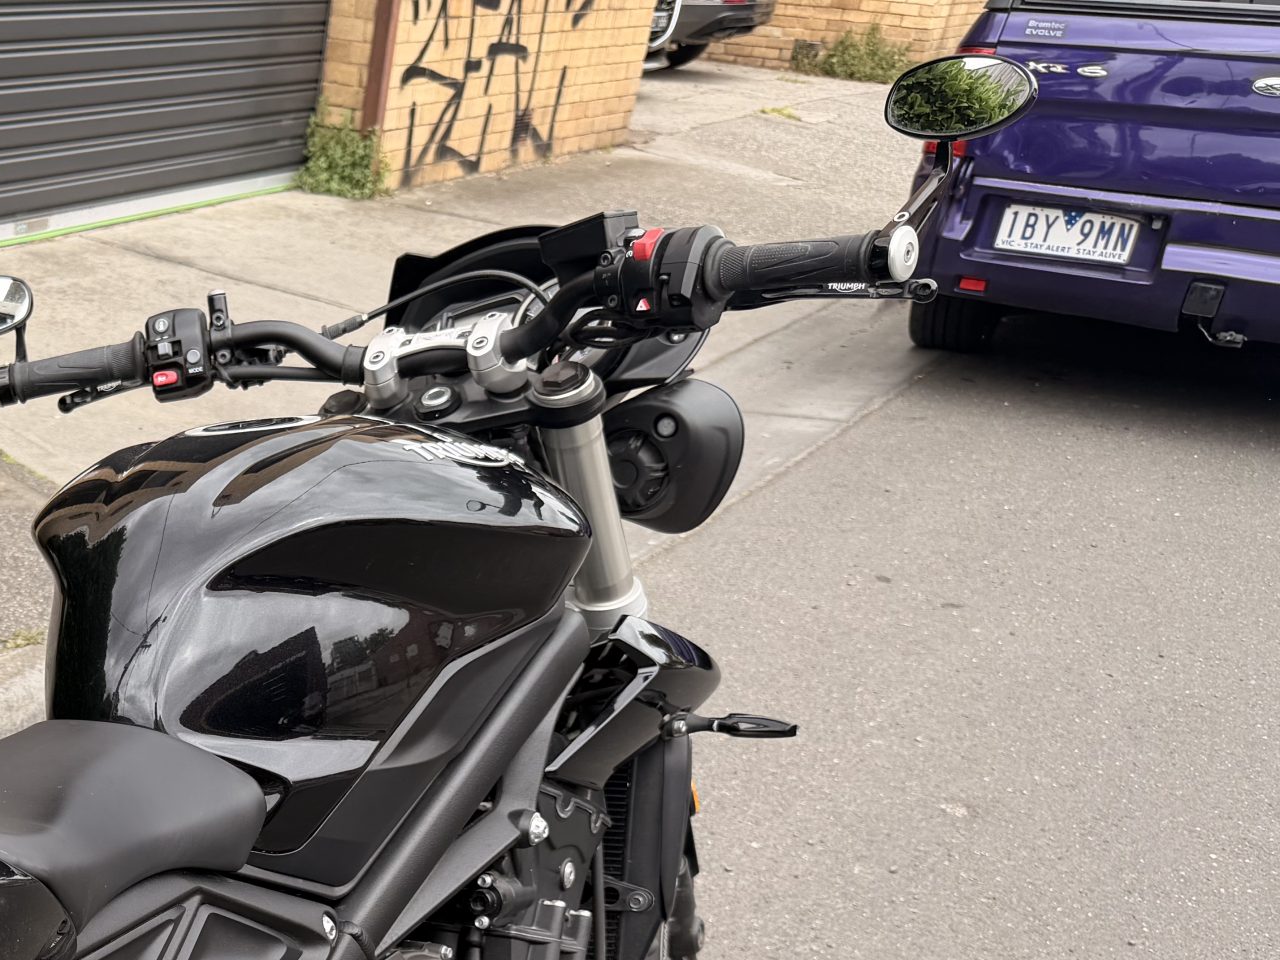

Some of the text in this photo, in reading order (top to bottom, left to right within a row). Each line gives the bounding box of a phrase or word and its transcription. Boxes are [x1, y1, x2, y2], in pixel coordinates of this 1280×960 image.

[1025, 28, 1063, 37] EVOLVE
[1008, 210, 1134, 253] 1BY 9MN
[1000, 239, 1015, 247] VIC
[1023, 242, 1044, 250] STAY
[1045, 244, 1071, 254] ALERT
[1076, 248, 1097, 256] STAY
[1097, 250, 1123, 260] ALIVE
[827, 282, 866, 293] TRIUMPH
[188, 366, 204, 374] MODE
